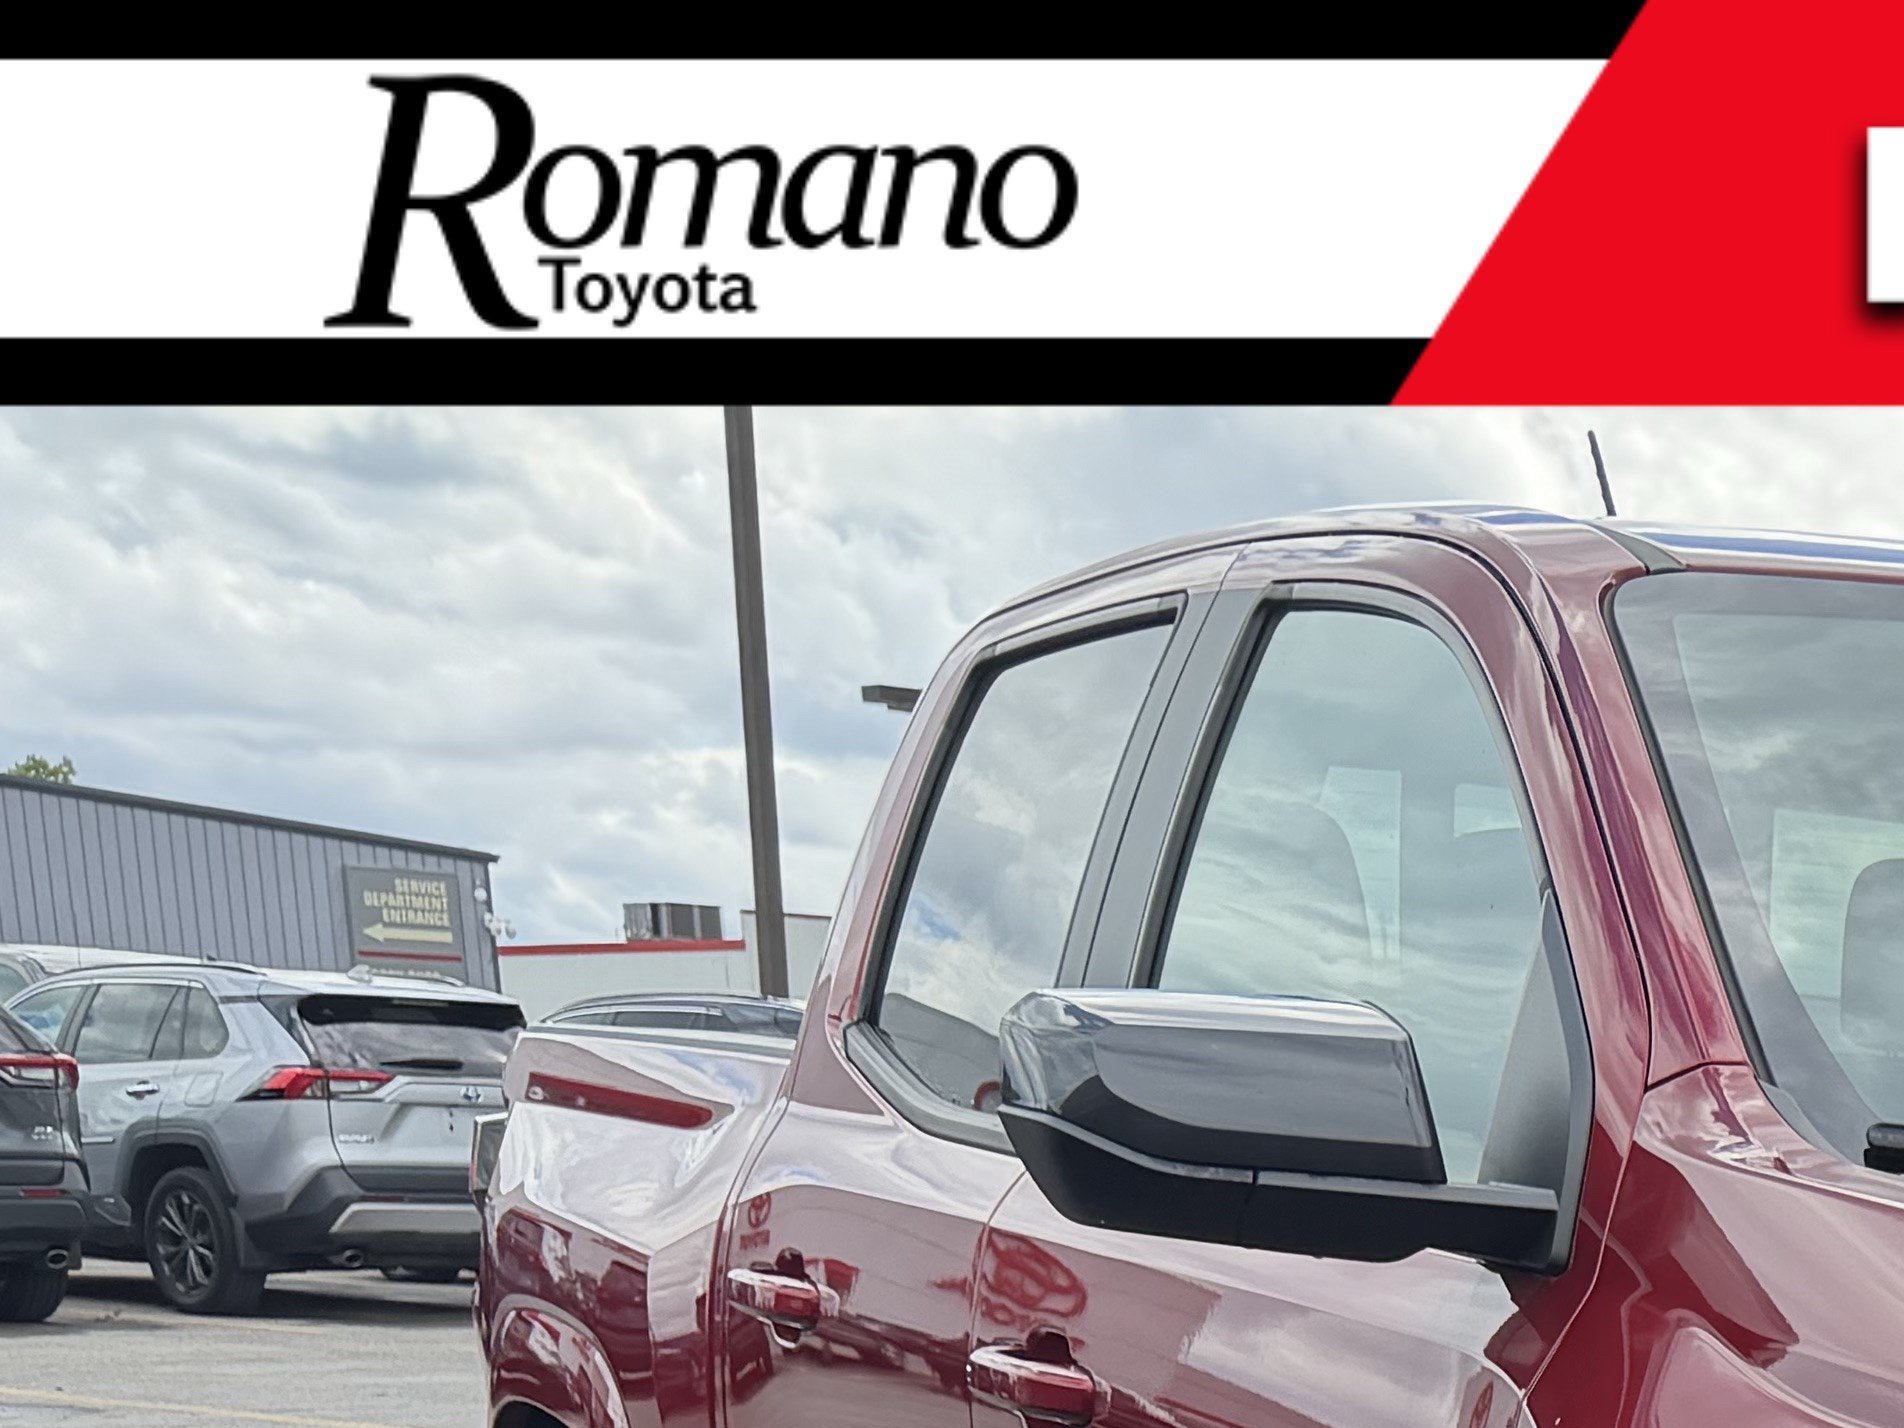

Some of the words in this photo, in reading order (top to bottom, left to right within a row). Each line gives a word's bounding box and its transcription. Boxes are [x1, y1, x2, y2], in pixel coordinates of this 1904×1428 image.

[395, 877, 447, 896] SERVICE
[363, 890, 448, 909] DEPARTMENT
[382, 908, 449, 927] ENTRANCE
